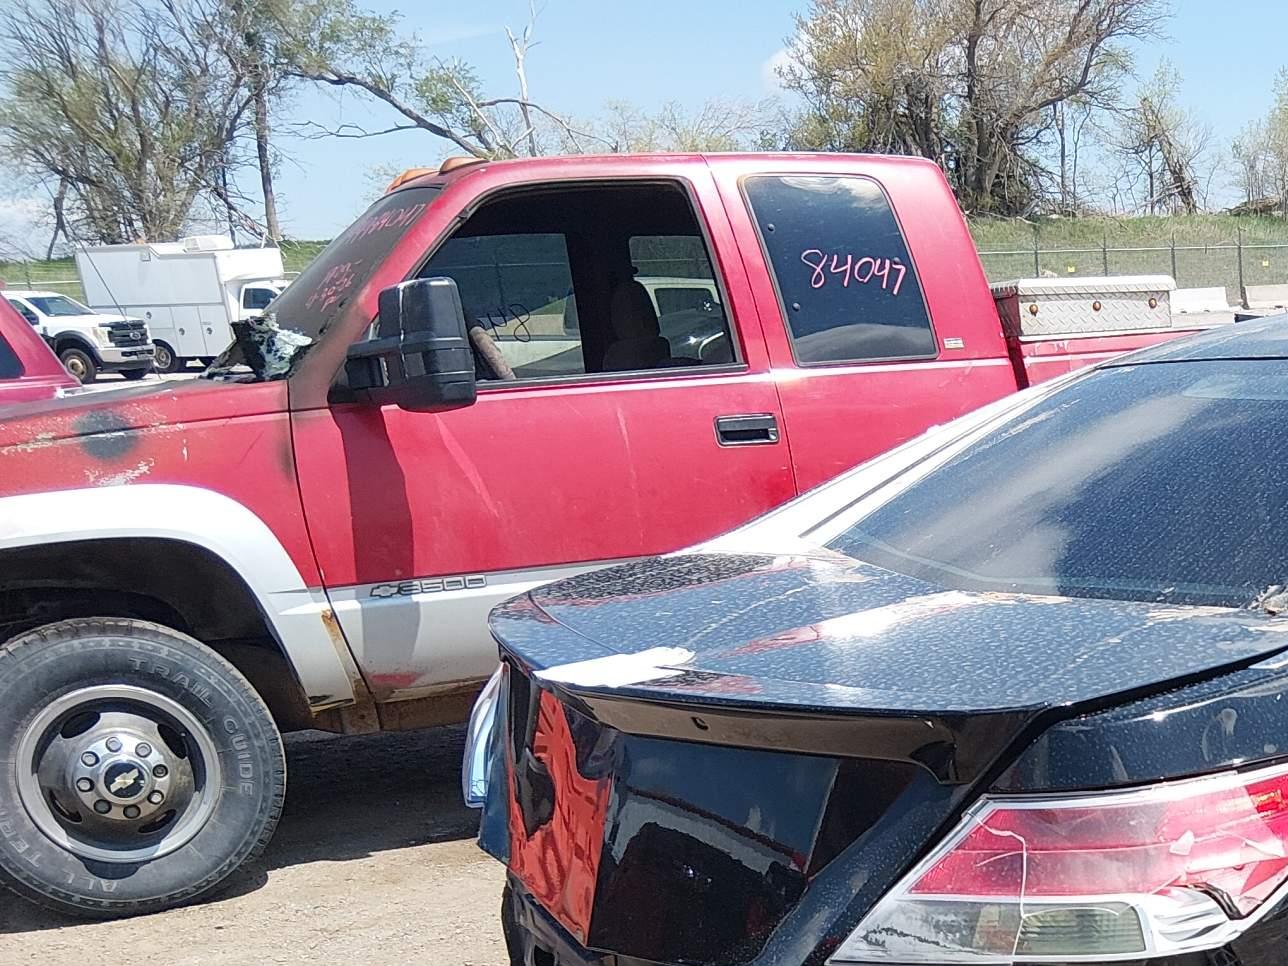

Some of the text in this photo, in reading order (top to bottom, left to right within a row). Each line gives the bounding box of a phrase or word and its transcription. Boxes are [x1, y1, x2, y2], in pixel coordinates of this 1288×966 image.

[800, 249, 906, 295] 84047
[398, 575, 488, 597] 3500
[128, 656, 256, 796] TRAIL GUIDE
